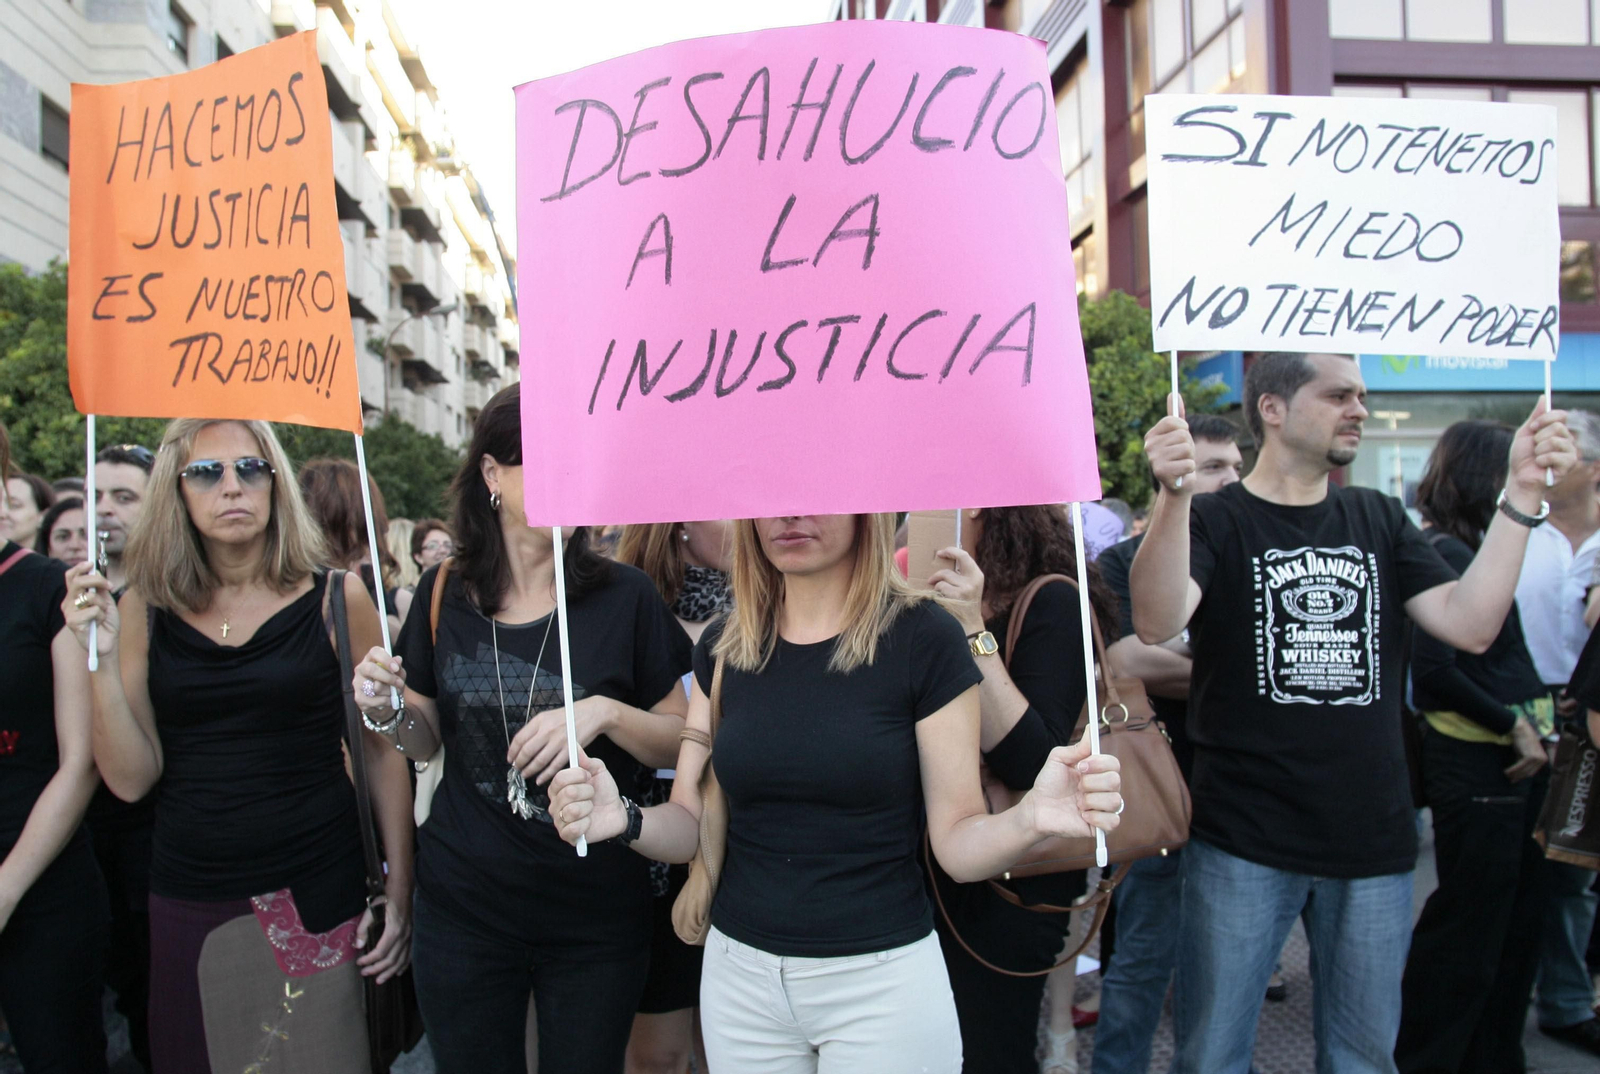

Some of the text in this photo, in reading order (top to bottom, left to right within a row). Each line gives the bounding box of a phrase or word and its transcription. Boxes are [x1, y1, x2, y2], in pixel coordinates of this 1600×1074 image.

[107, 71, 306, 184] HACEMOS
[540, 57, 1047, 203] DESAHUCIO
[1161, 105, 1296, 167] SI
[133, 182, 311, 250] JUSTICIA
[625, 192, 881, 290] A LA
[1248, 192, 1464, 262] MIEDO
[92, 269, 335, 324] ES NUESTRO
[1158, 276, 1559, 355] NO TIENEN PODER
[170, 332, 341, 399] TRABAJO!!
[588, 301, 1036, 415] INJUSTICIA
[1265, 551, 1368, 589] JACK DANIEL'S
[1307, 591, 1330, 599] Old
[1252, 557, 1266, 696] MADE IN TENNESSEE
[1281, 649, 1362, 664] WHISKEY
[1285, 623, 1359, 643] Tennessee
[1559, 749, 1598, 837] NESPRESSO
